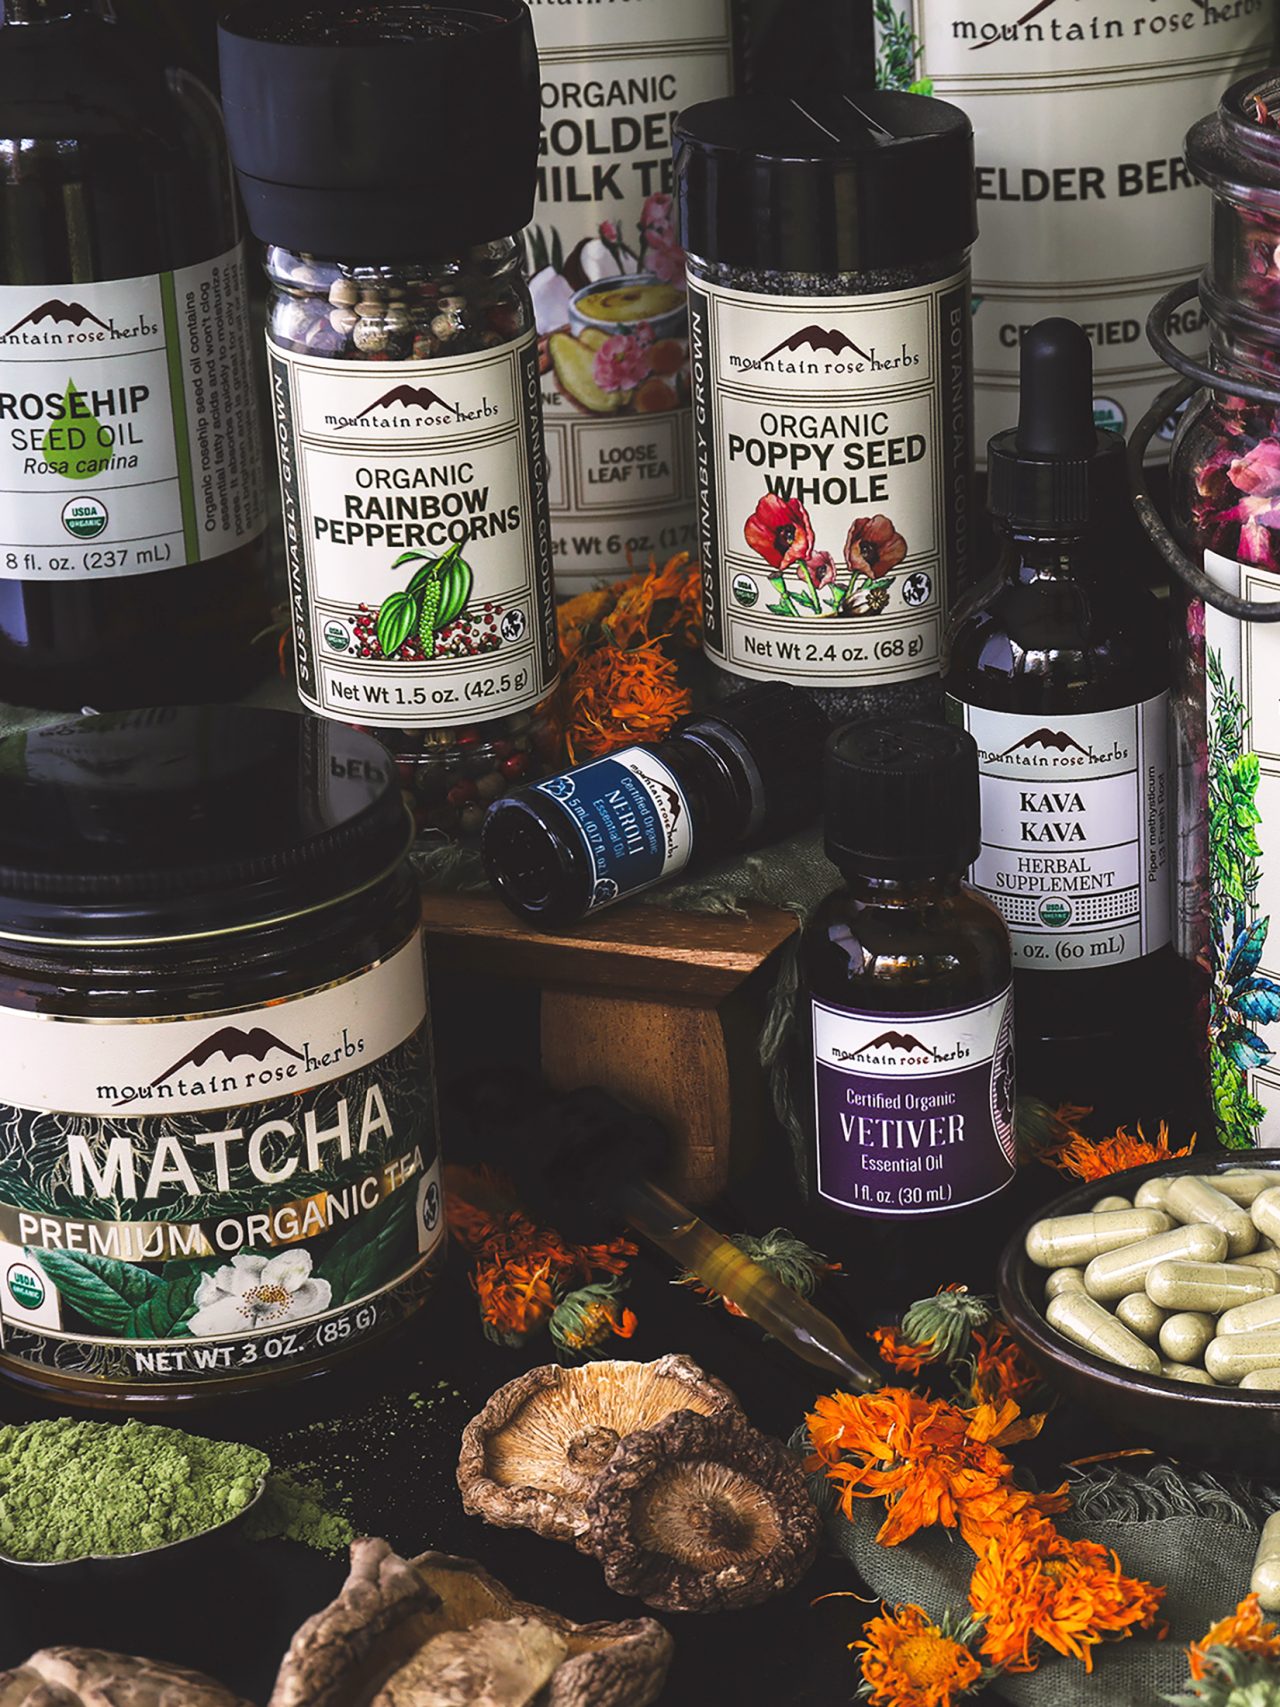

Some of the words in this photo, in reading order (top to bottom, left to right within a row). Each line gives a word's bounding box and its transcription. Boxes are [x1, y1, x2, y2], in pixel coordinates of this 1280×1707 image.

[952, 19, 1123, 42] mountain
[1134, 9, 1194, 37] rose
[540, 75, 677, 109] ORGANIC
[975, 166, 1106, 201] ELDER
[68, 329, 104, 344] rose
[109, 315, 158, 340] herbs
[729, 354, 820, 375] mountain
[824, 360, 865, 375] rose
[870, 344, 920, 370] herbs
[0, 385, 150, 421] ROSEHIP
[324, 412, 411, 430] mountain
[415, 416, 451, 427] rose
[455, 398, 499, 422] herbs
[11, 428, 86, 452] SEED
[96, 422, 144, 446] OIL
[760, 412, 889, 439] ORGANIC
[24, 457, 69, 475] Rosa
[76, 454, 139, 473] canina
[599, 444, 658, 465] LOOSE
[729, 434, 834, 472] POPPY
[843, 434, 927, 470] SEED
[355, 462, 474, 489] ORGANIC
[588, 465, 632, 484] LEAF
[637, 462, 670, 480] TEA
[344, 487, 489, 521] RAINBOW
[765, 474, 889, 505] WHOLE
[314, 505, 521, 548] PEPPERCORNS
[6, 553, 19, 570] 8
[24, 552, 42, 571] fl.
[50, 557, 76, 571] oz.
[83, 549, 128, 570] (237
[137, 543, 171, 564] mL)
[745, 635, 773, 657] Net
[776, 638, 800, 660] Wt
[805, 640, 836, 662] 2.4
[842, 647, 868, 661] oz.
[874, 640, 904, 661] (68
[908, 635, 924, 656] g)
[331, 680, 360, 702] Net
[363, 686, 389, 704] Wt
[395, 687, 426, 705] 1.5
[432, 689, 460, 705] oz.
[464, 675, 510, 701] (42.5
[514, 668, 529, 691] g)
[978, 750, 1049, 766] mountain
[1053, 756, 1084, 766] rose
[1088, 742, 1129, 765] herbs
[1019, 792, 1086, 813] KAVA
[604, 789, 644, 855] NEROLI
[1020, 821, 1087, 842] KAVA
[1017, 857, 1090, 873] HERBAL
[996, 872, 1115, 892] SUPPLEMENT
[1023, 945, 1050, 959] oz.
[1056, 940, 1084, 962] (60
[1090, 934, 1126, 955] mL)
[96, 1078, 239, 1106] mountain
[245, 1063, 298, 1089] rose
[303, 1028, 366, 1075] herbs
[832, 1047, 896, 1065] mountain
[900, 1055, 929, 1065] rose
[933, 1042, 970, 1063] herbs
[846, 1088, 901, 1110] Certified
[905, 1091, 956, 1111] Organic
[66, 1083, 395, 1200] MATCHA
[839, 1112, 965, 1149] VETIVER
[861, 1154, 922, 1172] Essential
[926, 1154, 943, 1171] Oil
[18, 1212, 201, 1257] PREMIUM
[215, 1176, 380, 1252] ORGANIC
[383, 1145, 425, 1193] TEA
[135, 1349, 188, 1373] NET
[194, 1346, 236, 1370] WT
[242, 1342, 258, 1363] 3
[264, 1334, 304, 1359] OZ.
[315, 1318, 351, 1347] (85
[354, 1306, 378, 1335] G)
